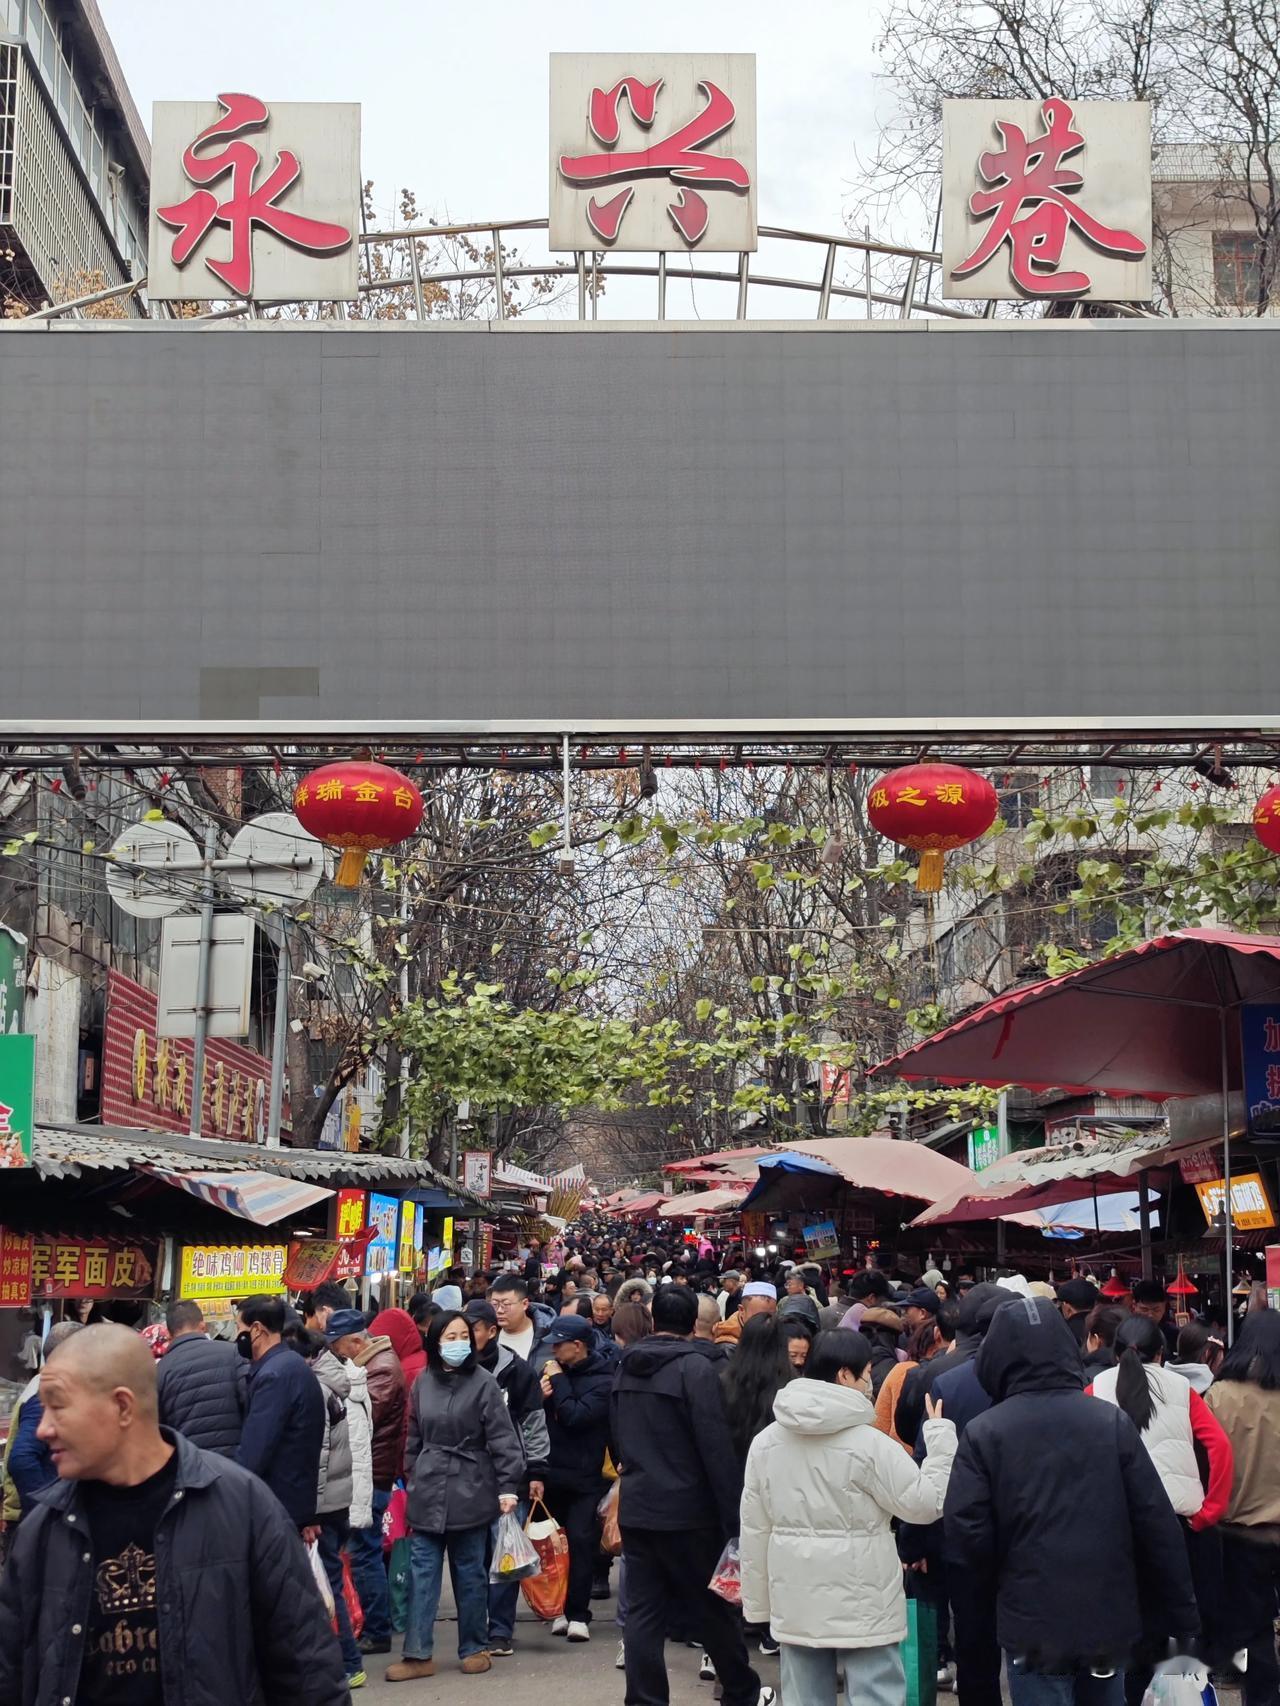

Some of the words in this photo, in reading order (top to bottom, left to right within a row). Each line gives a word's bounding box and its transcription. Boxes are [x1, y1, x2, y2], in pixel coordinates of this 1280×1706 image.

[156, 76, 1147, 295] 永兴巷
[32, 1245, 136, 1288] 军军面皮
